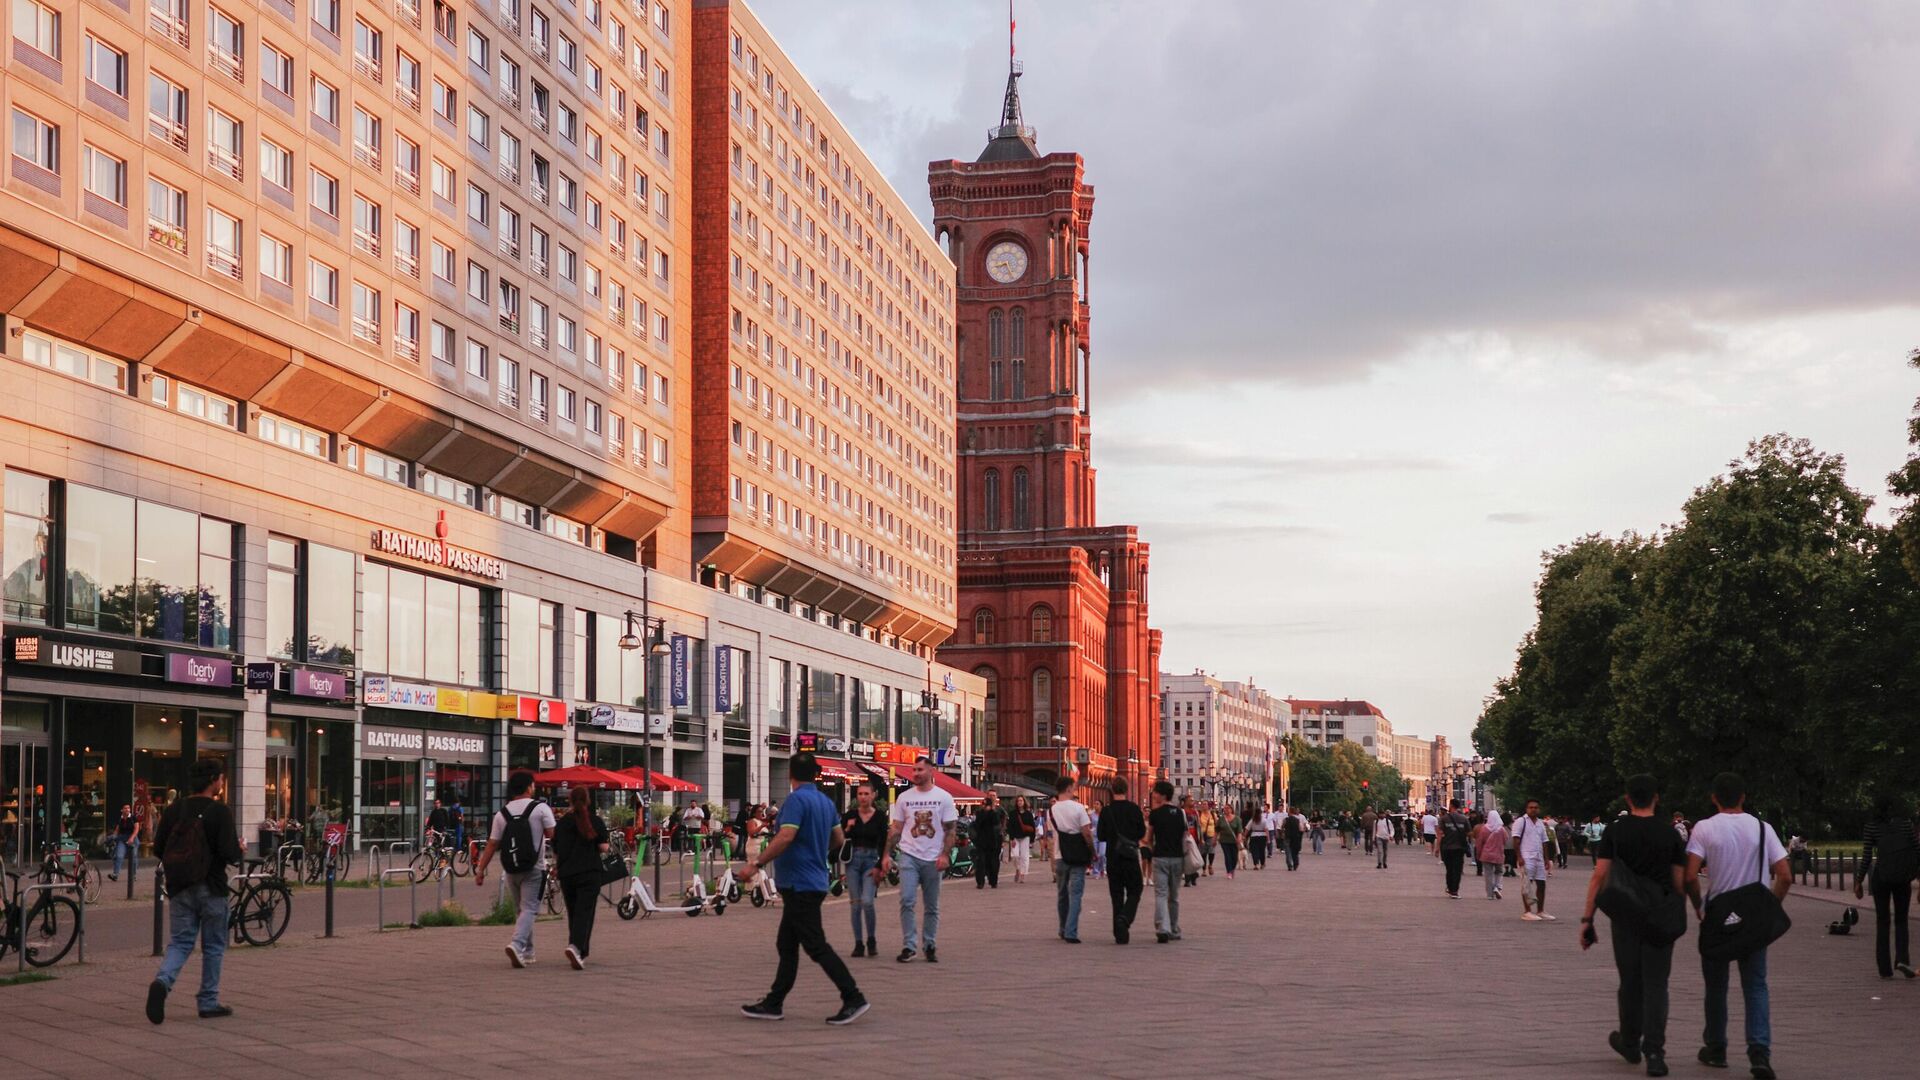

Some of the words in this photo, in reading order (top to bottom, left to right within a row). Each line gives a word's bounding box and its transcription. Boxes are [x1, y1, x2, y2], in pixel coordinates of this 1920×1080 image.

[381, 530, 441, 564] RATHAUS
[447, 548, 507, 580] PASSAGEN
[15, 637, 38, 645] LUSH
[52, 644, 95, 668] LUSH
[95, 649, 114, 659] FRESH
[675, 639, 683, 688] DECATHLON
[187, 658, 216, 682] liberty
[719, 650, 727, 695] DECATHLON
[309, 674, 333, 694] liberty
[367, 731, 423, 749] RATHAUS
[427, 735, 484, 752] PASSAGEN
